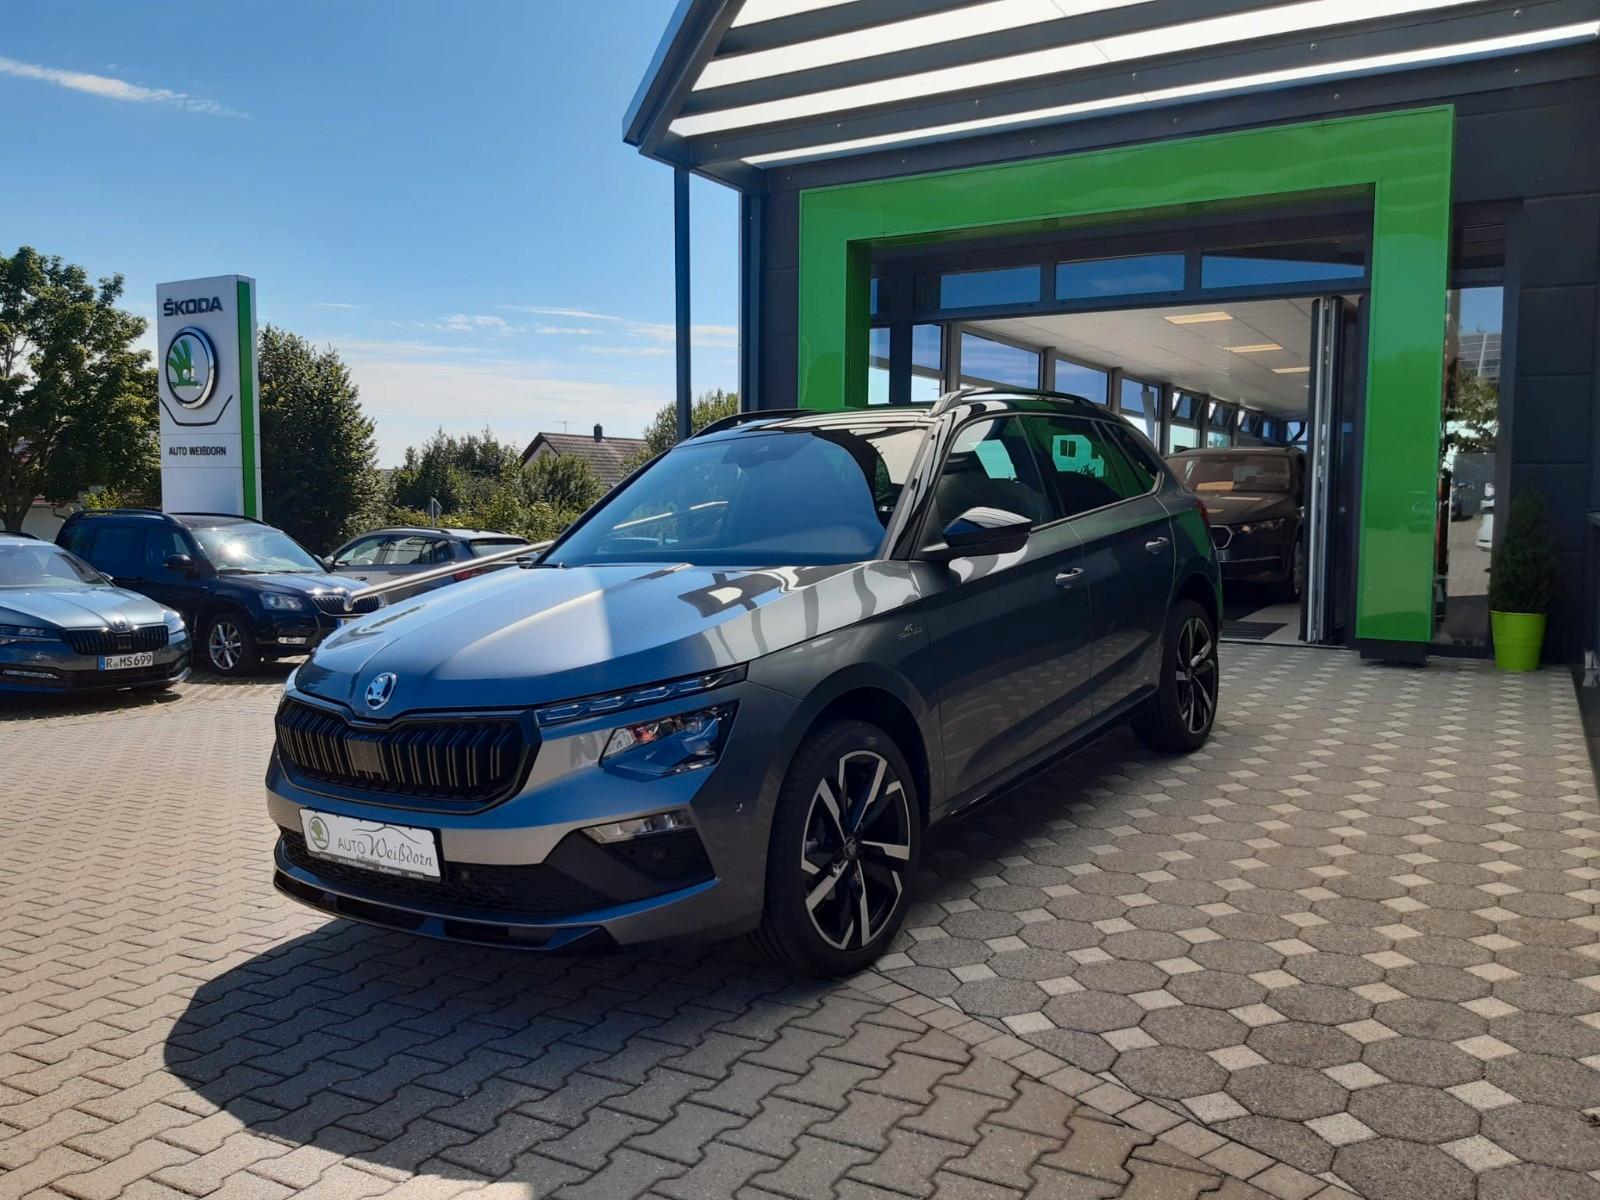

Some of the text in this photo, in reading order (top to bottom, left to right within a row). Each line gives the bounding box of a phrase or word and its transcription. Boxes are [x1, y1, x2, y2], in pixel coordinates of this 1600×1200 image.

[163, 296, 223, 317] ŠKODA
[168, 446, 187, 456] AUTO
[106, 657, 113, 668] R
[338, 837, 366, 854] AUTO
[357, 833, 433, 867] Weißdorn
